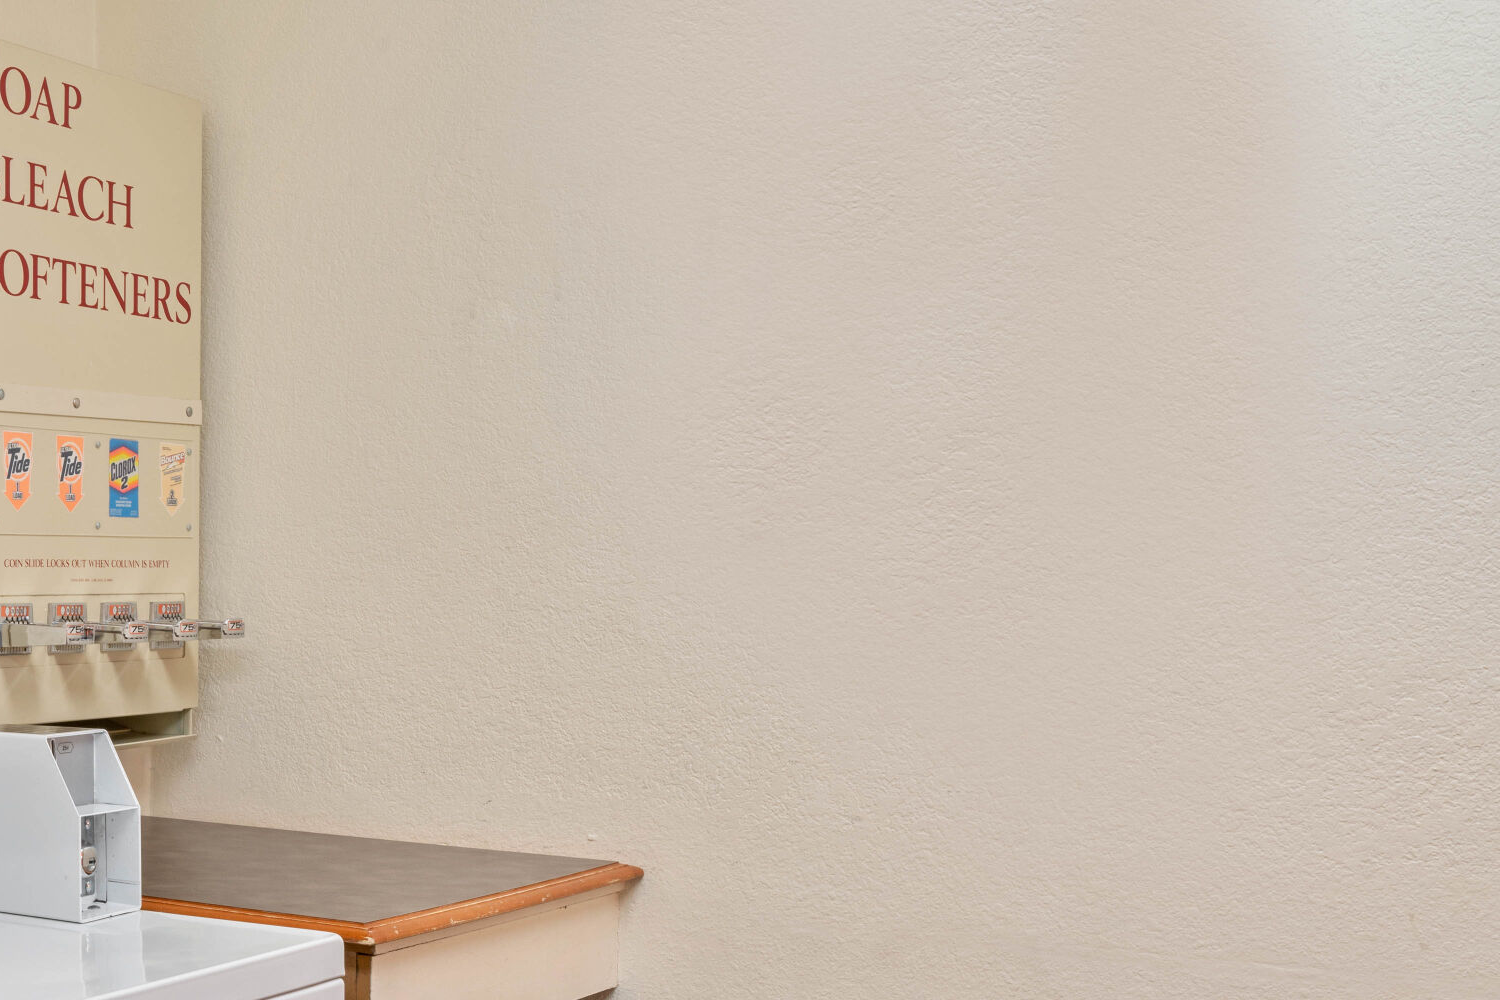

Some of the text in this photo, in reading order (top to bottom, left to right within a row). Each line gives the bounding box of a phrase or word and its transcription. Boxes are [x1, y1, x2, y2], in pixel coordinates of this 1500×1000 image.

[6, 447, 31, 479] Tide
[60, 450, 82, 482] Tide
[110, 455, 137, 482] CLOROX
[121, 476, 128, 490] 2
[4, 558, 171, 569] COIN SLIDE LOCKS OUT WHEN COLUMN IS EMPTY
